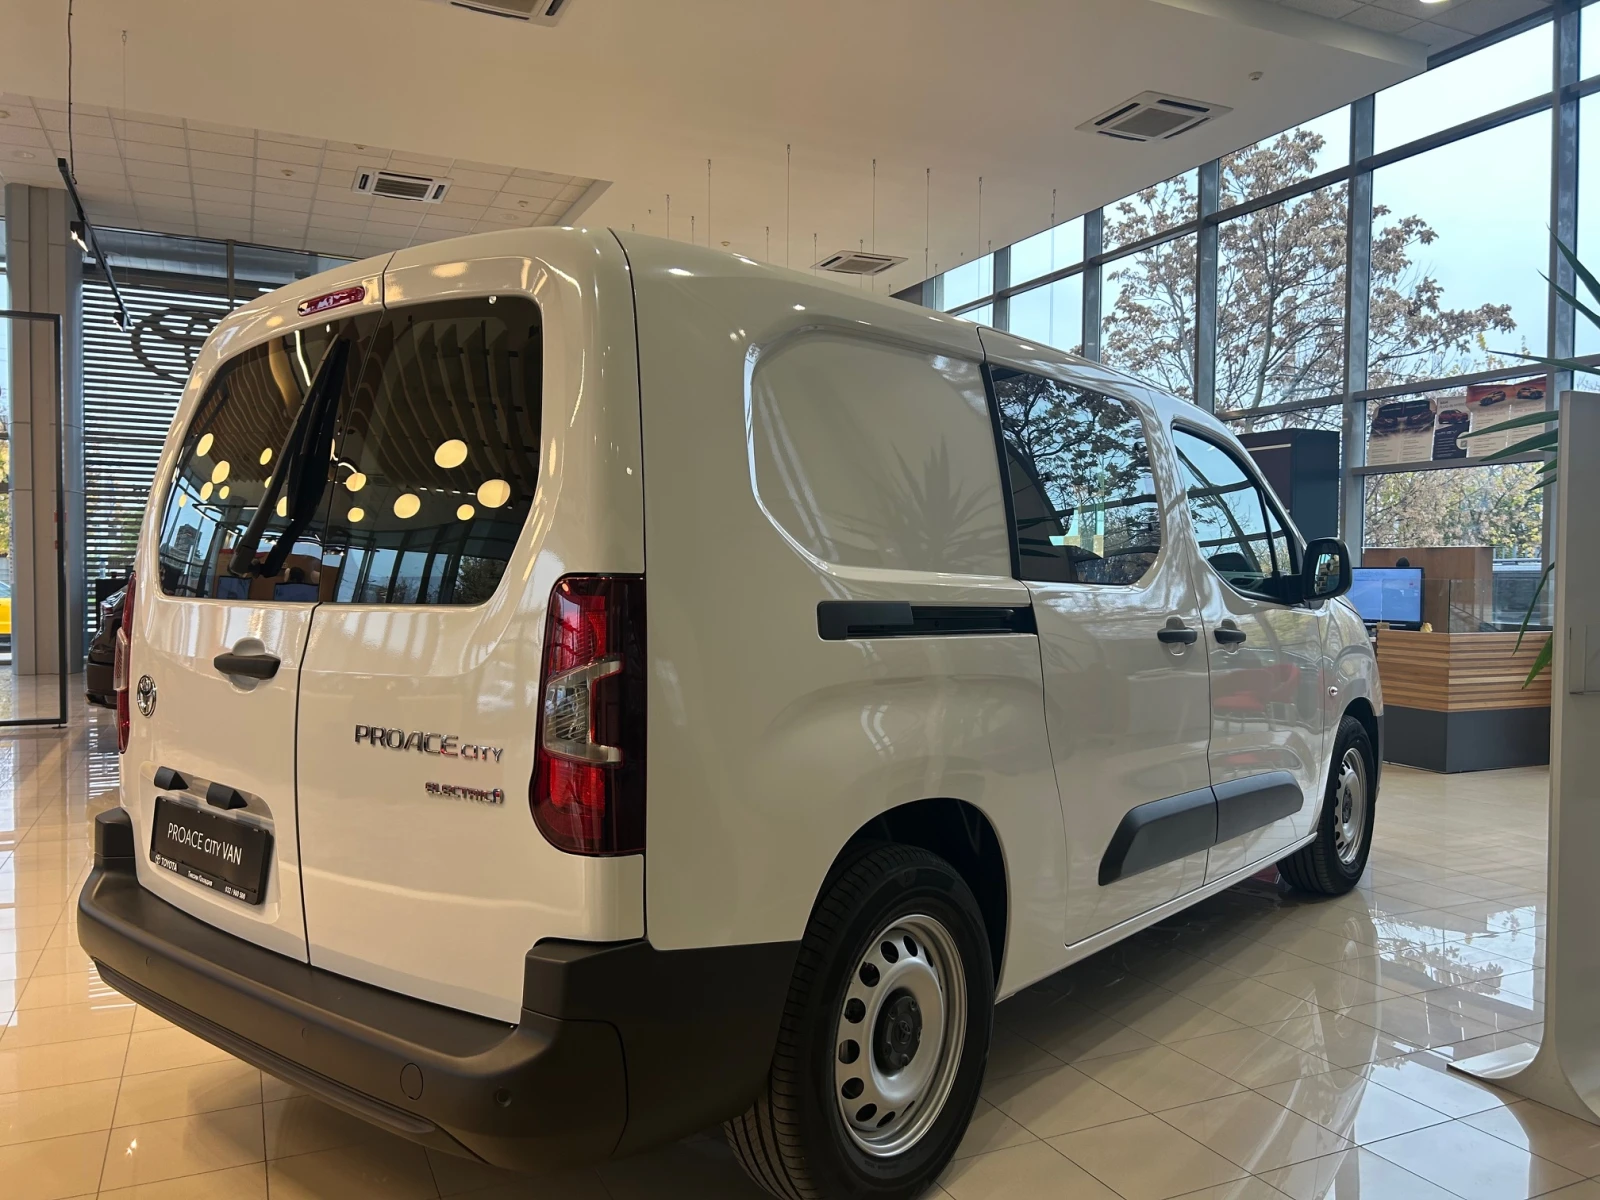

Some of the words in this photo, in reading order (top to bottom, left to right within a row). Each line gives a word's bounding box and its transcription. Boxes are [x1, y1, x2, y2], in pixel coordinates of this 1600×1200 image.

[354, 724, 459, 757] PROACE
[460, 743, 503, 762] CITY
[167, 822, 204, 850] PROACE
[204, 838, 222, 856] CITY
[222, 841, 242, 865] VAN
[161, 857, 178, 872] TOYOTA
